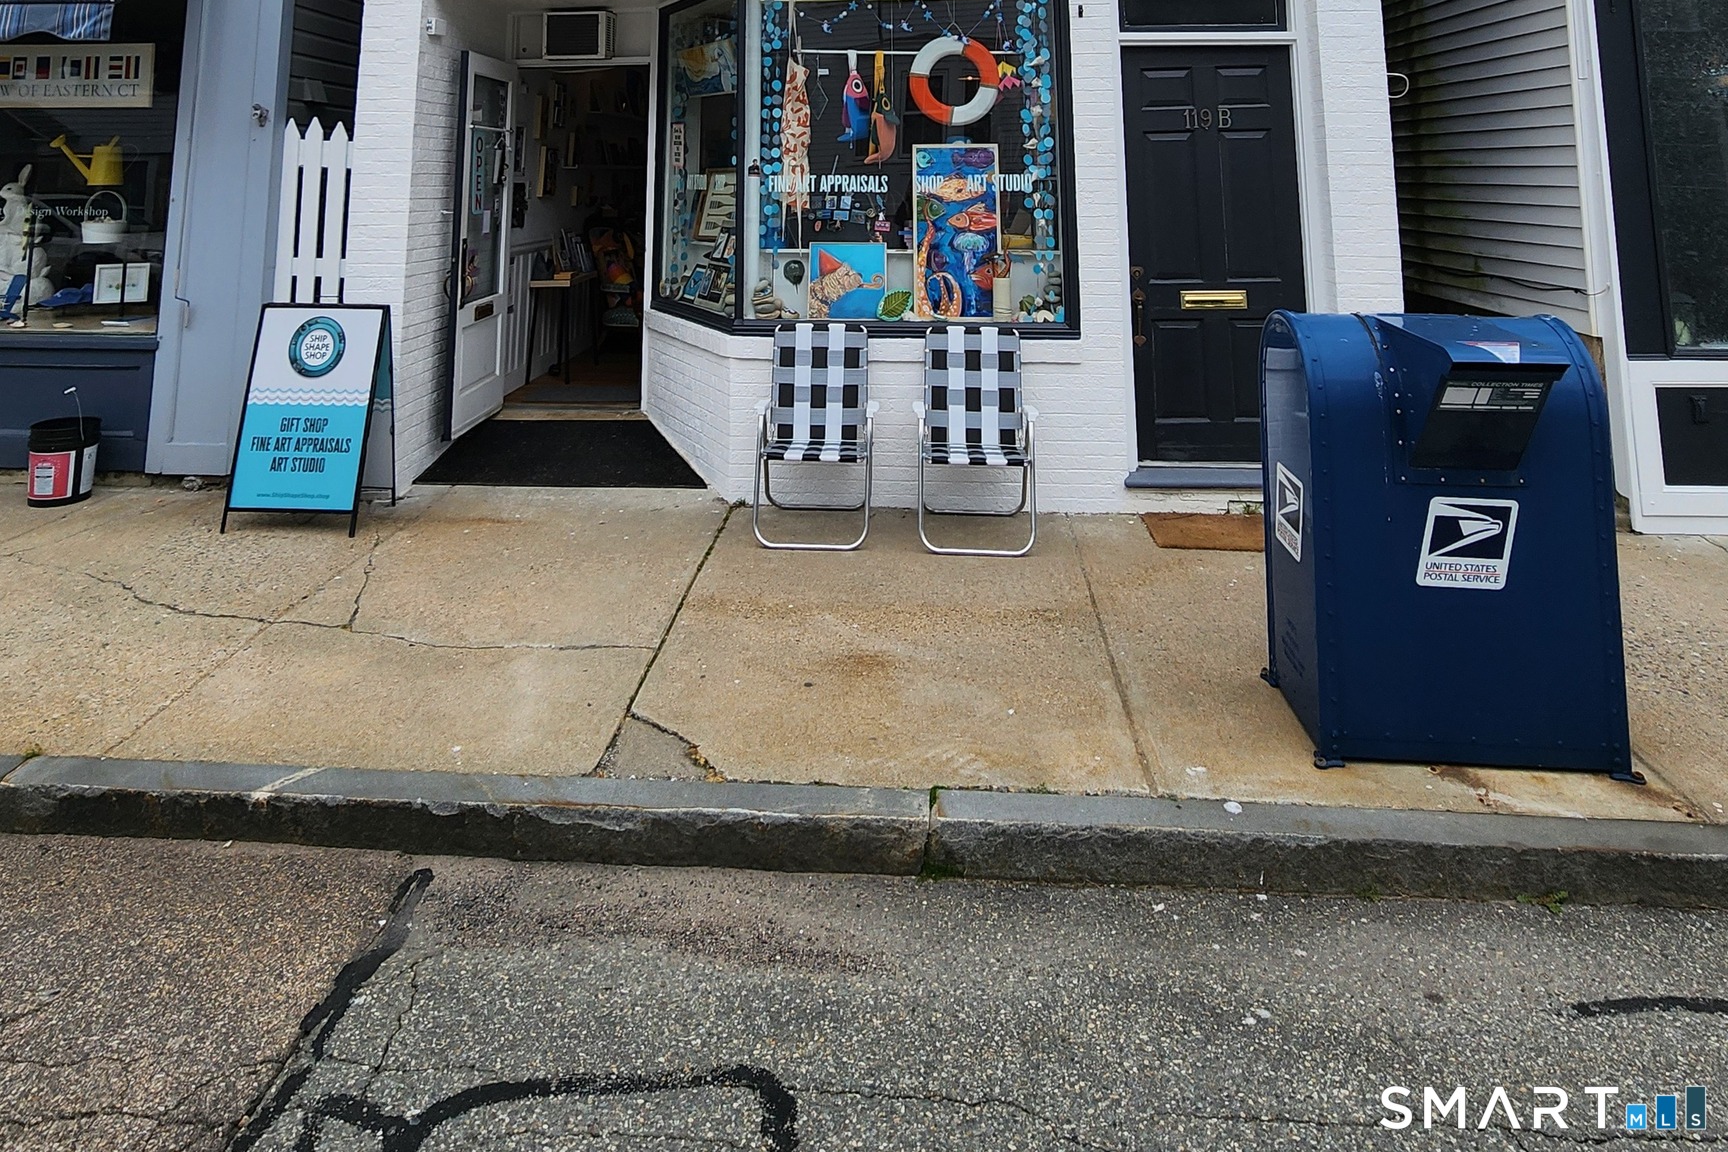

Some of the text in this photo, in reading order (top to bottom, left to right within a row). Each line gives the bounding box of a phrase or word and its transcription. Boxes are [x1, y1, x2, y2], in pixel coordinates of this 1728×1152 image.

[18, 83, 39, 98] OF
[43, 83, 112, 98] EASTERN
[117, 83, 140, 97] CT
[1183, 108, 1232, 130] 119 B
[475, 137, 484, 210] OPEN
[768, 174, 889, 193] FINE ART APPRAISALS
[916, 173, 1033, 193] SHOP ART STUDIO
[55, 205, 109, 217] Workshop
[309, 334, 328, 343] SHIP
[304, 342, 330, 352] SHAPE
[304, 351, 327, 360] SHOP
[280, 417, 329, 433] GIFT SHOP
[250, 436, 352, 453] FINE ART APPRAISALS
[269, 456, 326, 473] ART STUDIO
[1425, 561, 1498, 573] UNITED STATES
[1423, 572, 1501, 584] POSTAL SERVICE
